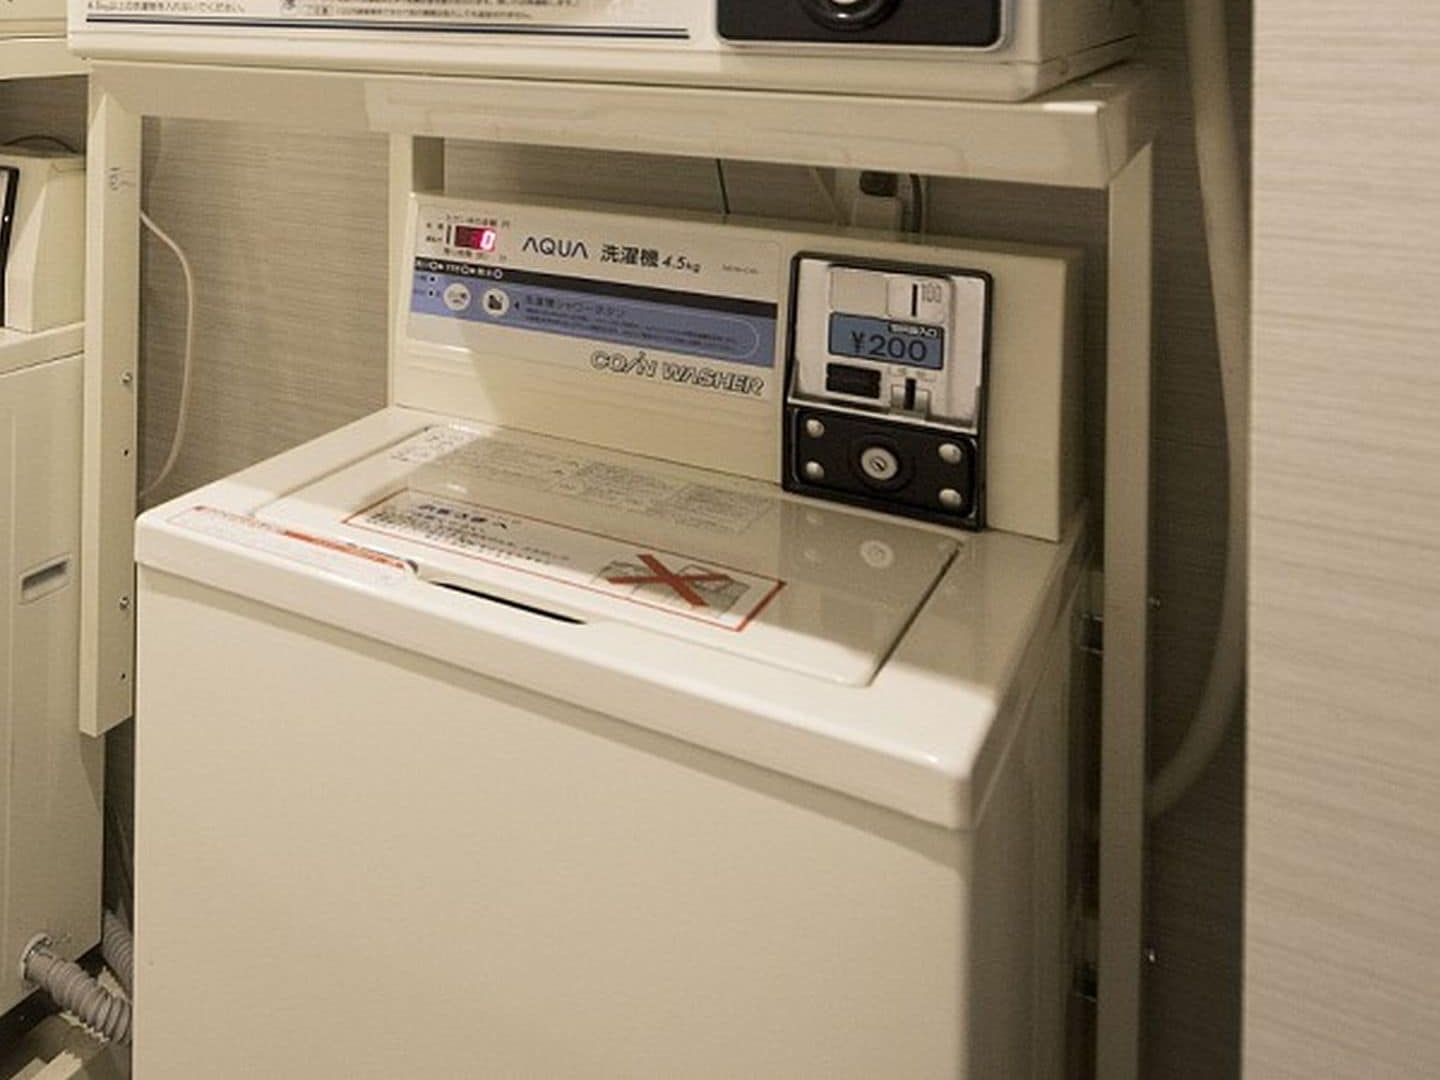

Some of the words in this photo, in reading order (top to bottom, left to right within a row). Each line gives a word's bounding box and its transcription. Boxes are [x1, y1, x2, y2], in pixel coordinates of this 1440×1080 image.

[480, 230, 496, 251] 0
[522, 236, 588, 260] AQUA
[600, 244, 660, 268] 洗濯機
[661, 251, 702, 274] 4.5kg
[851, 329, 928, 362] ¥200
[659, 360, 766, 397] WASHER
